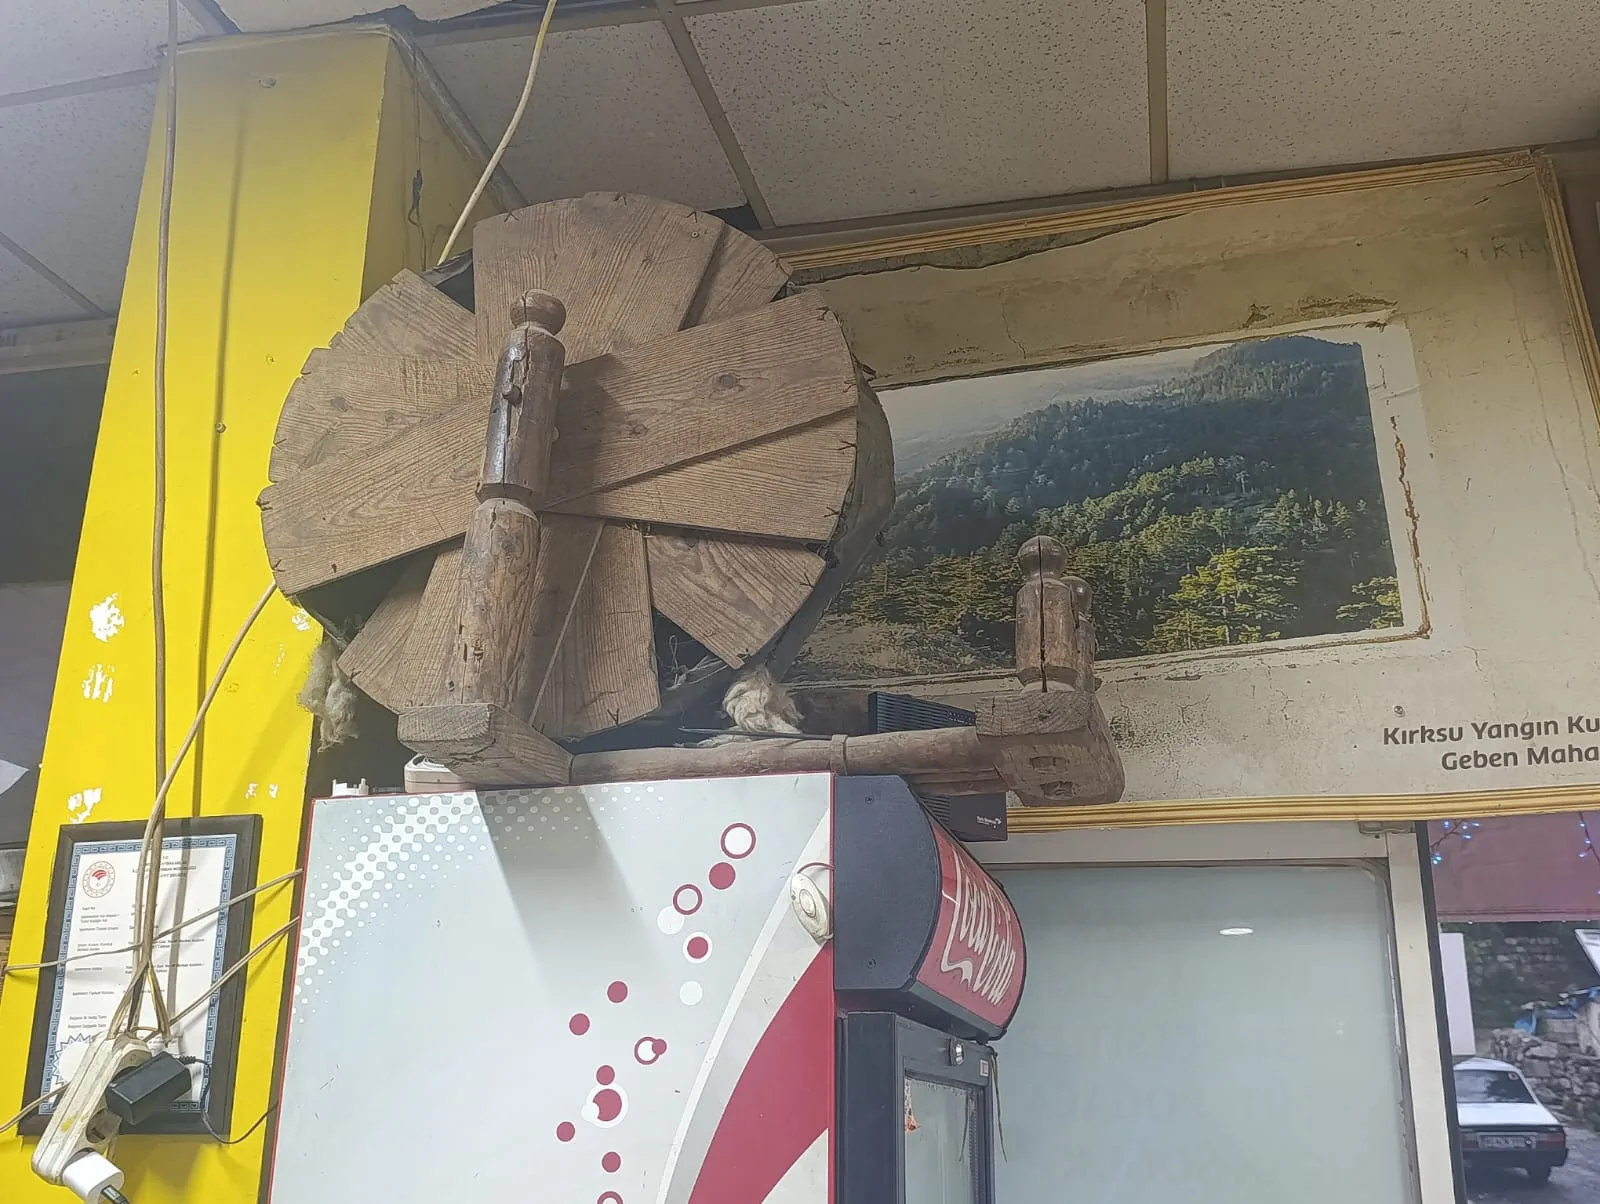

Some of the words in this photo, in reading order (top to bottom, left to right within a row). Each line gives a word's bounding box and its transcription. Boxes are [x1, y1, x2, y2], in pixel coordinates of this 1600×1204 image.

[1383, 725, 1463, 745] Kırksu
[1470, 720, 1559, 740] Yangın
[1441, 750, 1518, 770] Geben
[1527, 744, 1600, 766] Maha
